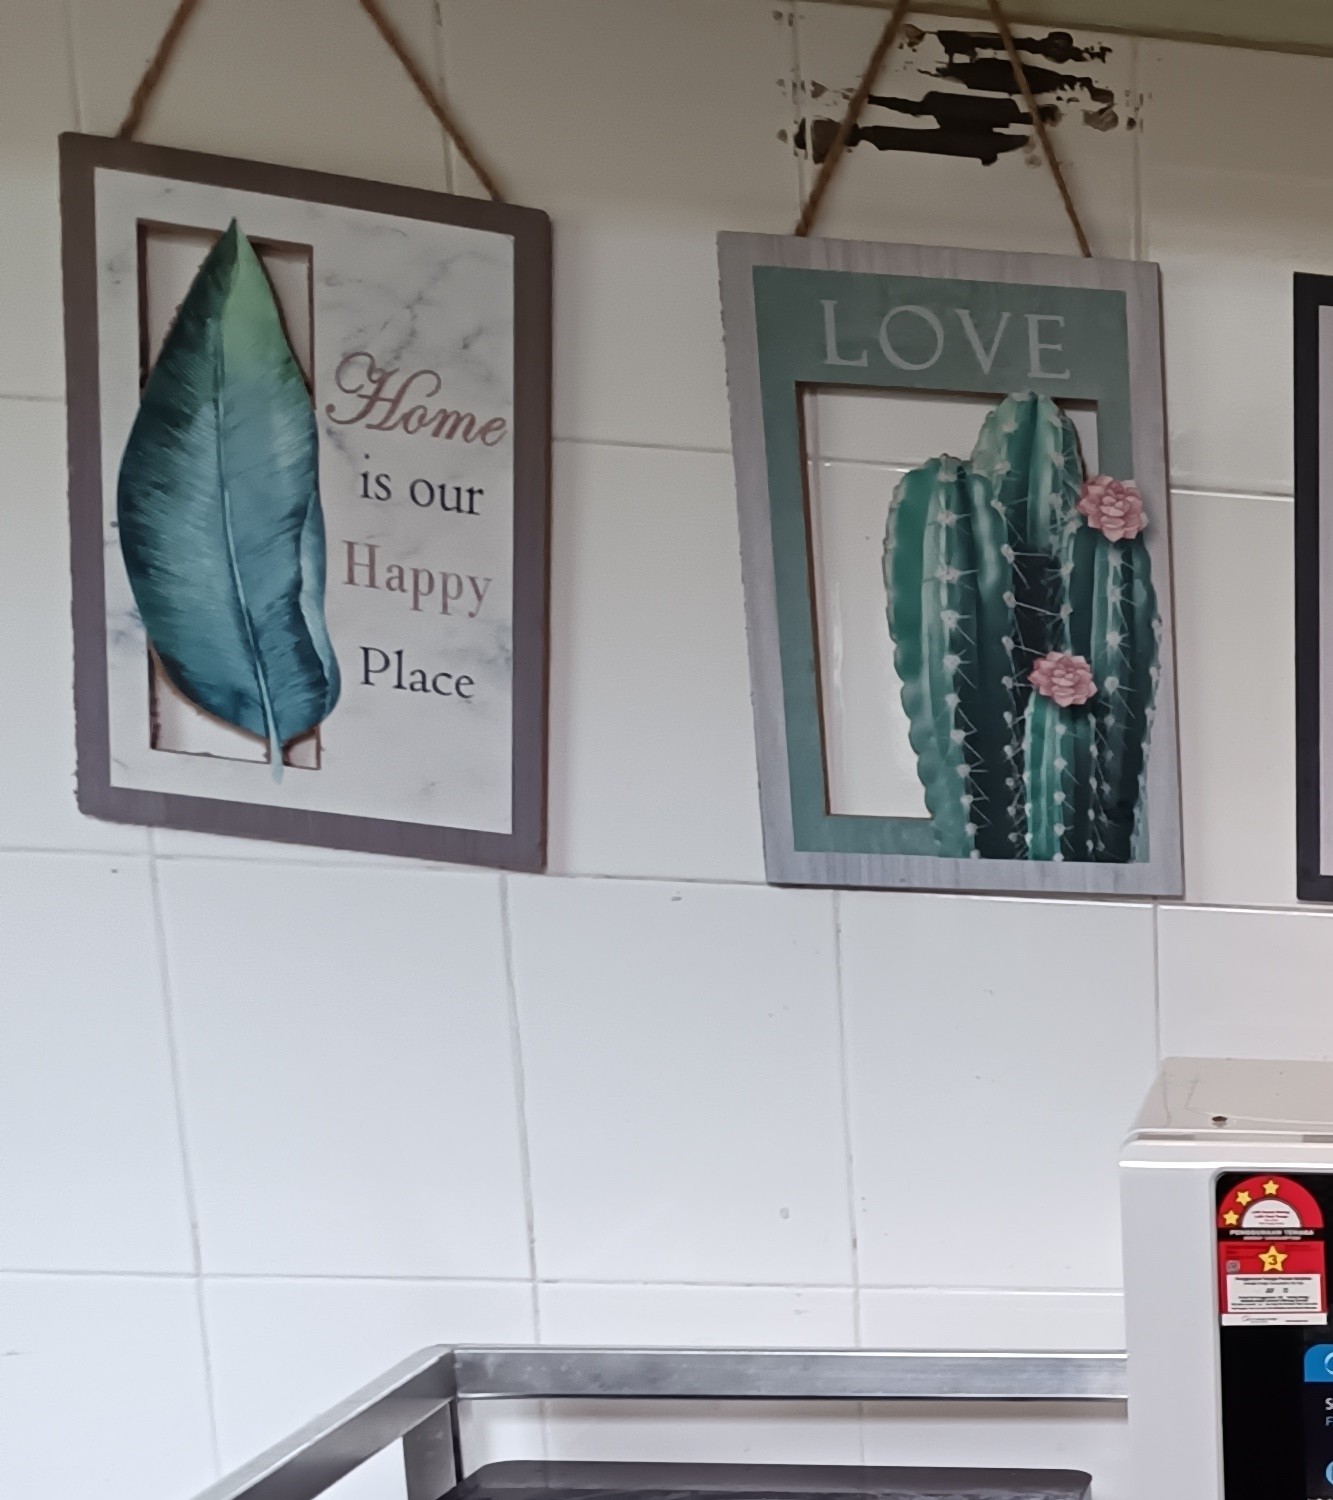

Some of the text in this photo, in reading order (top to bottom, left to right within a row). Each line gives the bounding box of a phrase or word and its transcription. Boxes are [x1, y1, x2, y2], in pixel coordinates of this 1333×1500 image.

[820, 299, 1071, 380] LOVE
[325, 351, 507, 446] Home
[360, 454, 485, 516] is our
[341, 539, 492, 618] Happy
[359, 646, 475, 699] Place
[1267, 1254, 1279, 1266] 3
